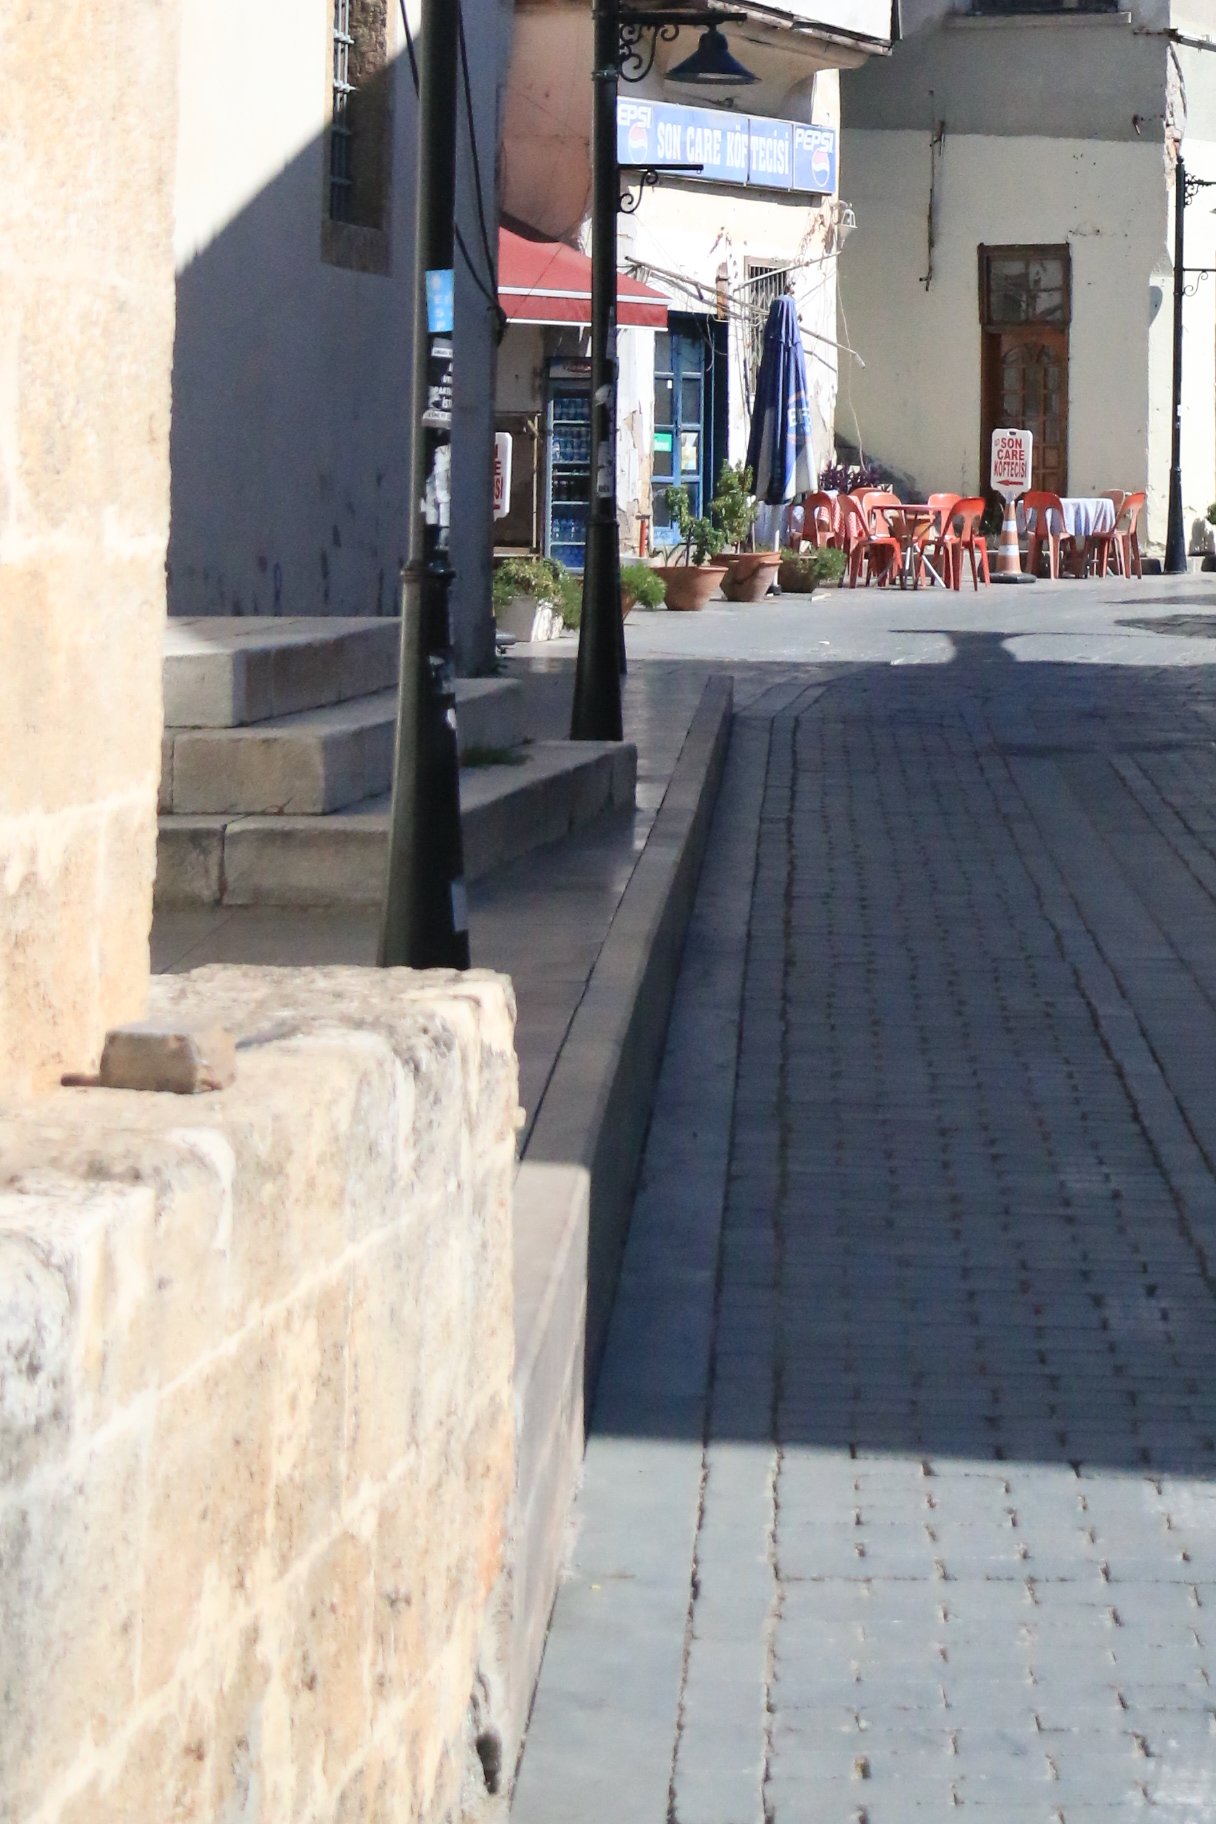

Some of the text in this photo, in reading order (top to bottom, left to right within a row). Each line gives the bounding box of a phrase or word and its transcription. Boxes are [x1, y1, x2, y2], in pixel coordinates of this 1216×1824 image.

[617, 103, 651, 129] EPSI
[657, 121, 681, 161] SON
[686, 126, 721, 165] CARE
[795, 127, 834, 154] PEPSI
[997, 449, 1025, 461] CARE
[1000, 437, 1022, 449] SON
